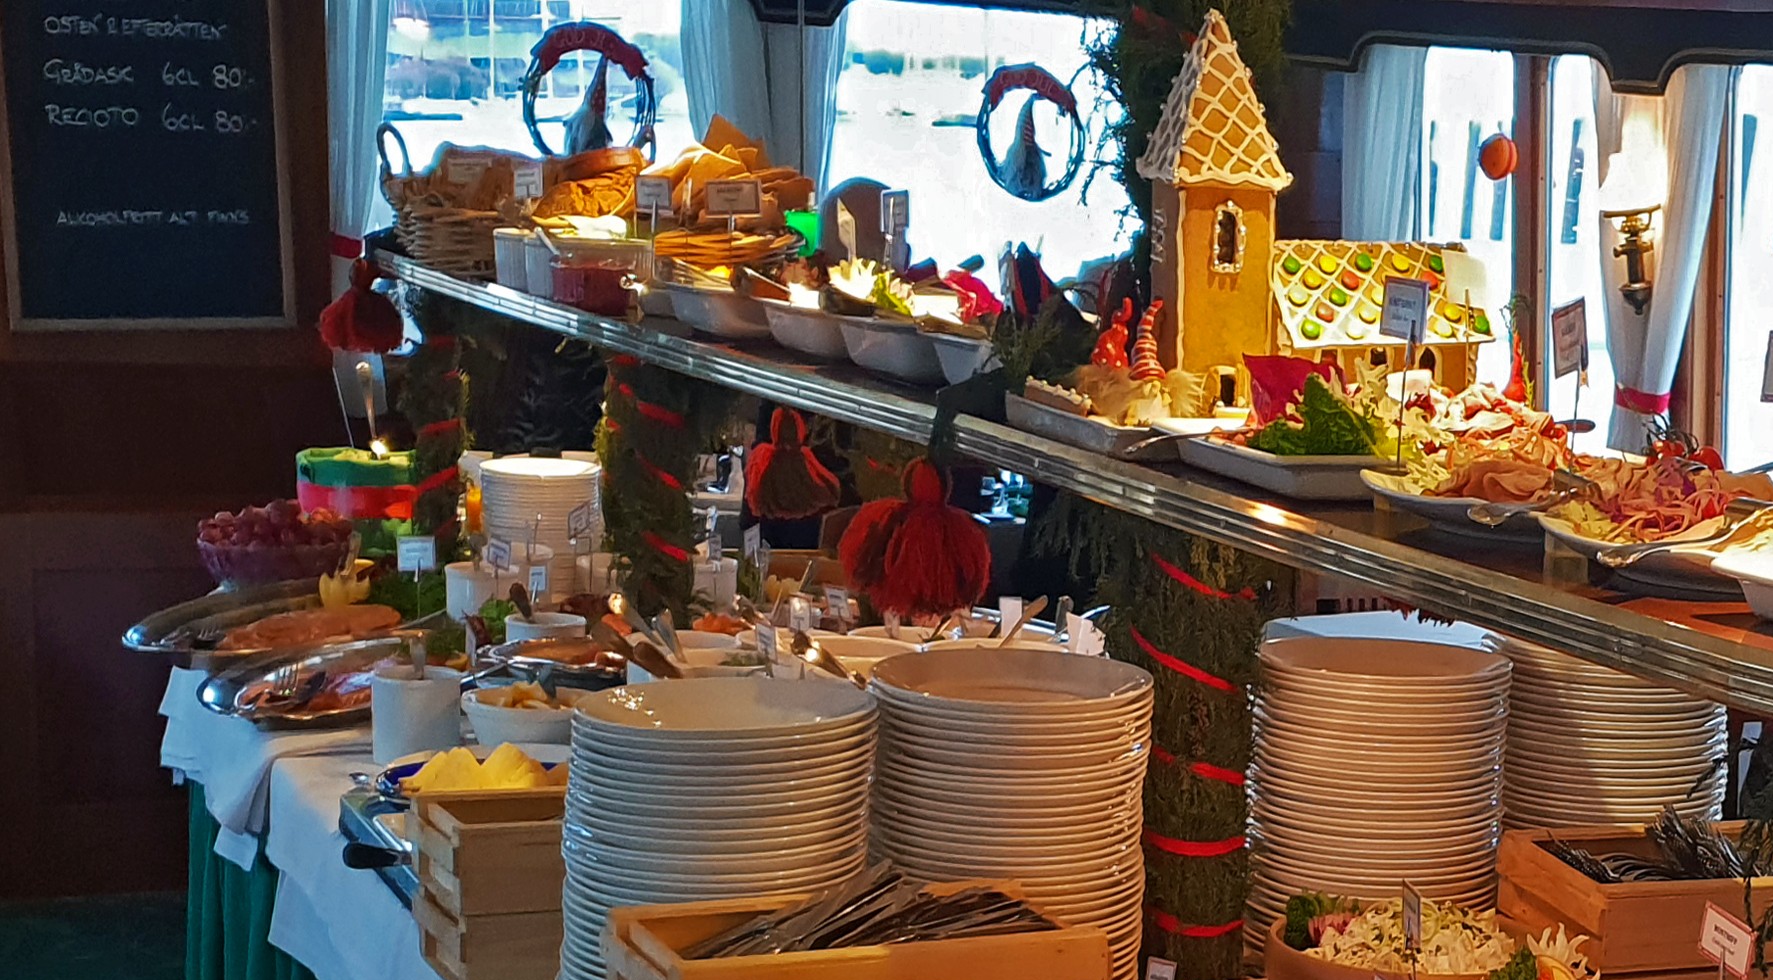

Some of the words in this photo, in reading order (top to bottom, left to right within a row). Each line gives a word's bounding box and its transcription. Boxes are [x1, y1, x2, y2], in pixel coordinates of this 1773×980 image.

[44, 13, 102, 35] OSTEN
[162, 61, 199, 87] 6CL
[162, 102, 204, 131] 6CL
